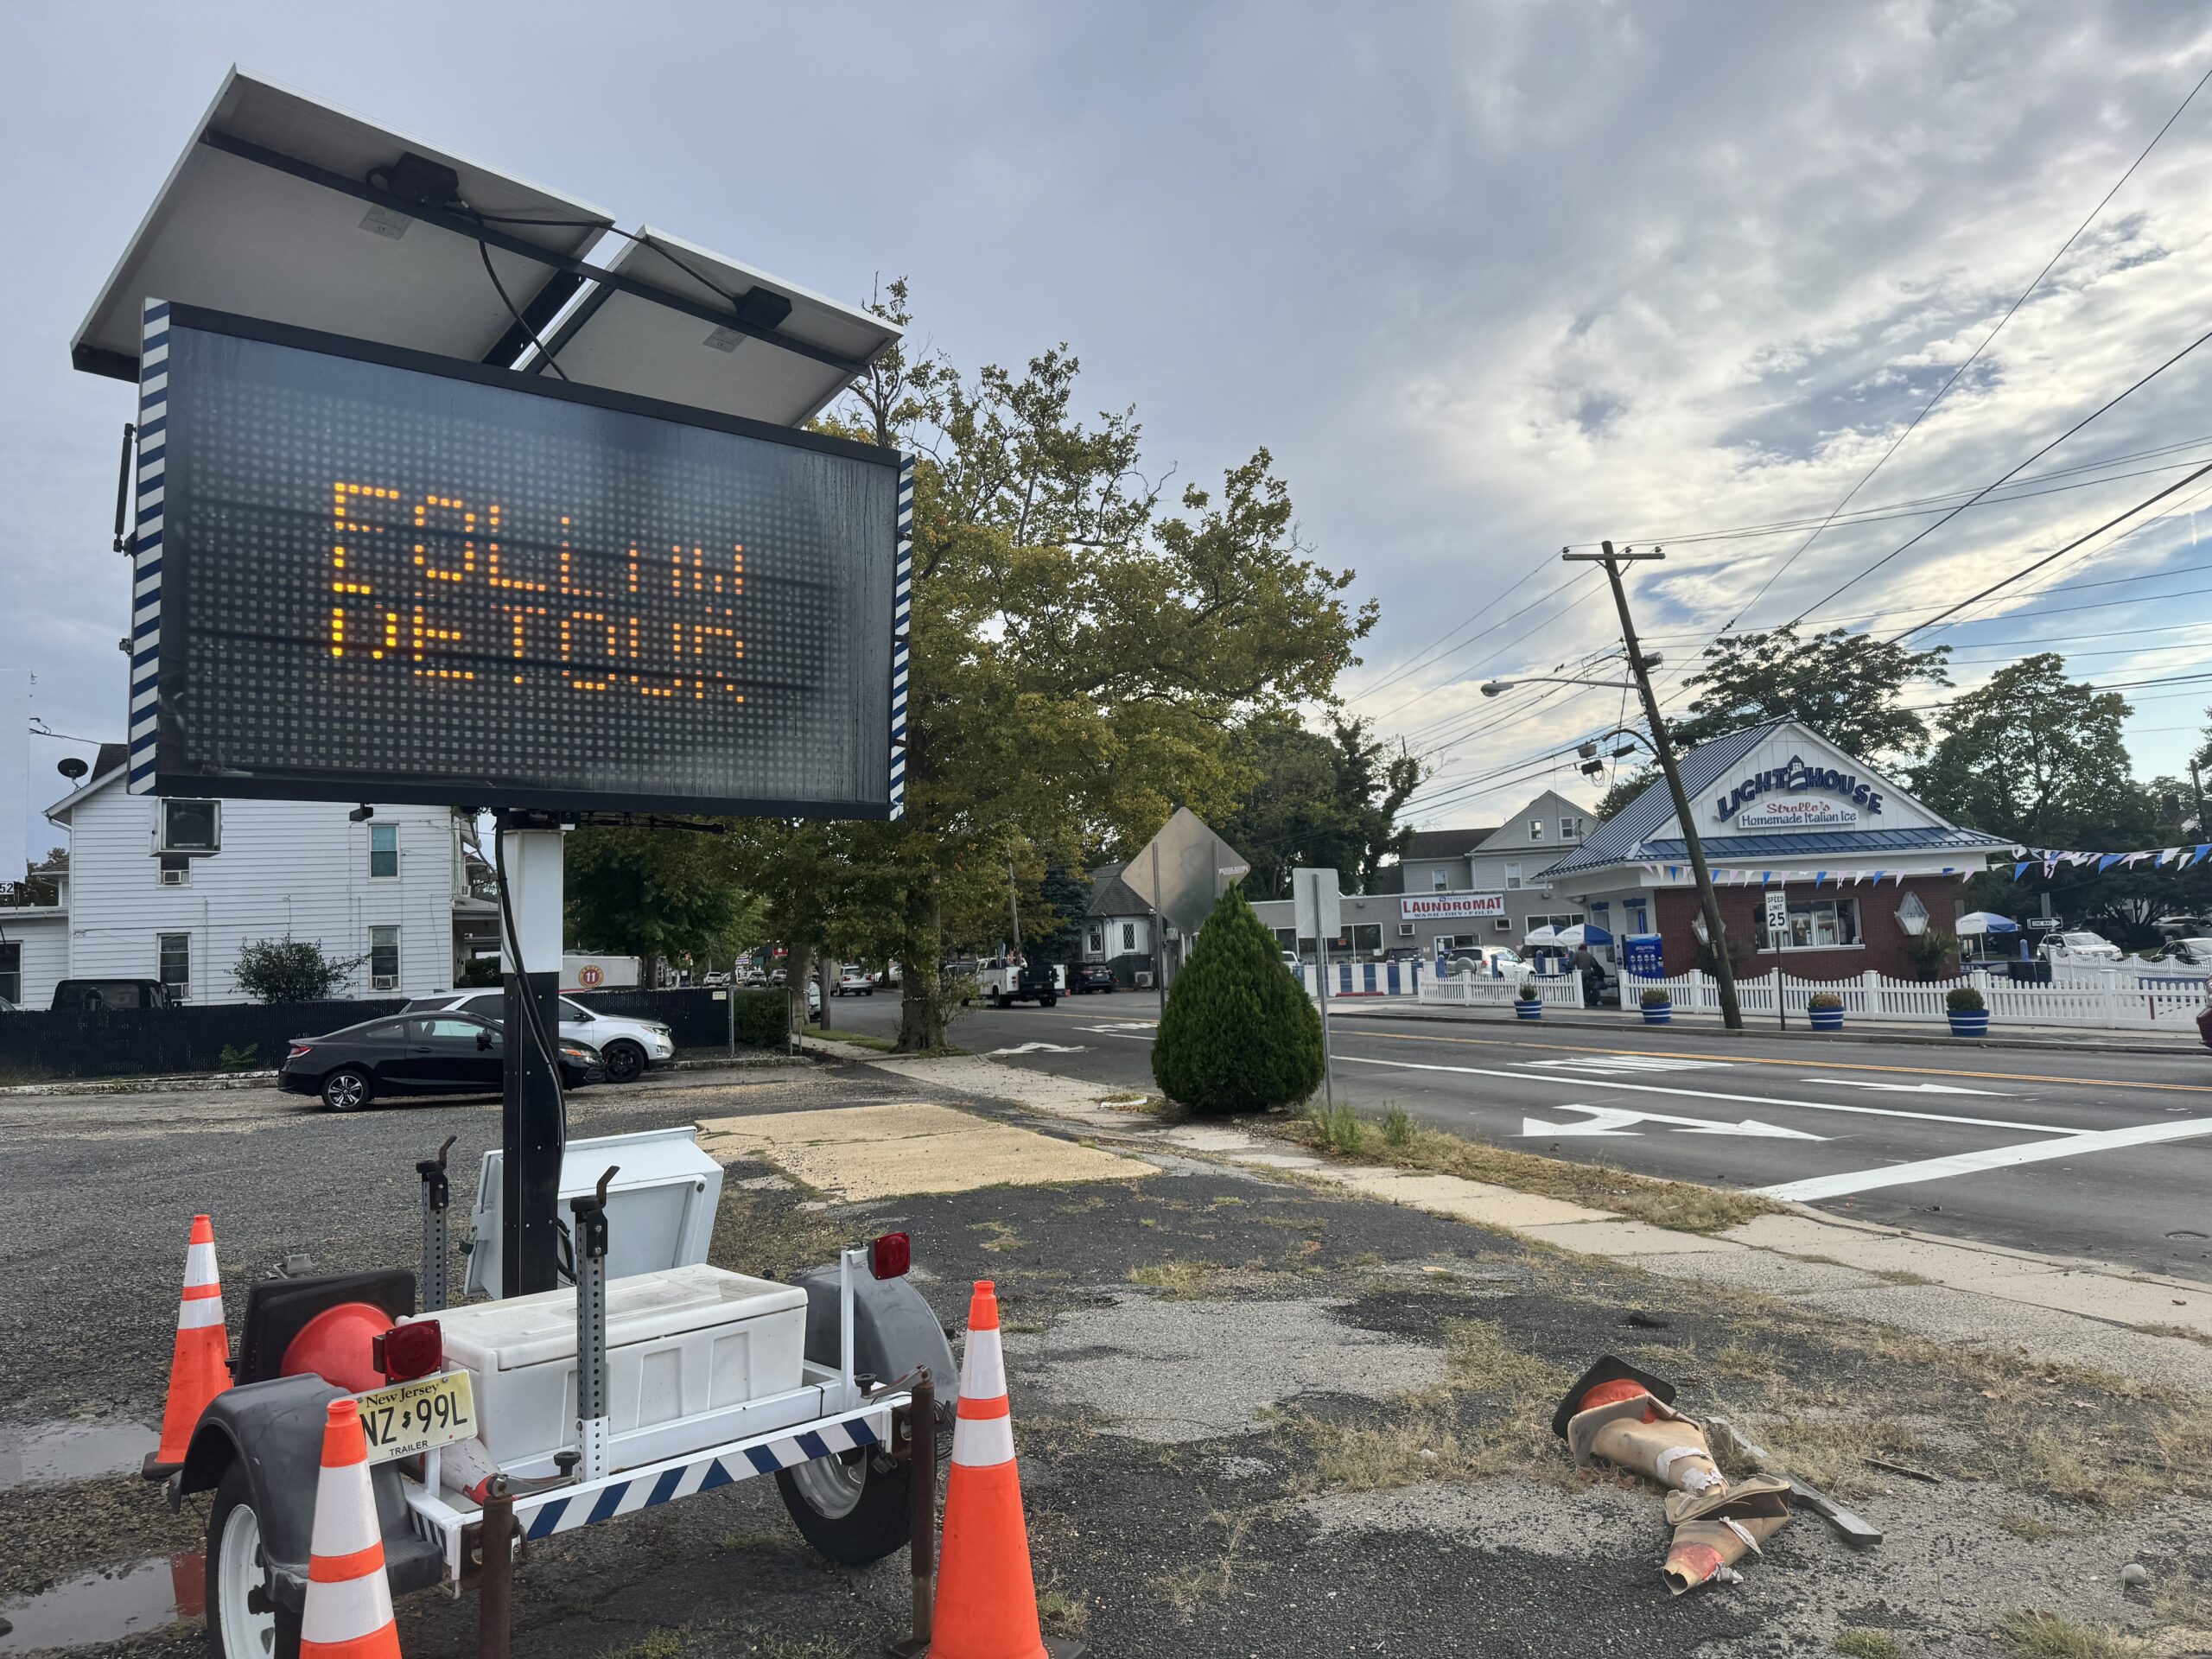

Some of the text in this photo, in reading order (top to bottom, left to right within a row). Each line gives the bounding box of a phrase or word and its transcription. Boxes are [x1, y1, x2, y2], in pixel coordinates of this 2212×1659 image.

[1766, 801, 1830, 814] Strollo's
[1742, 810, 1856, 826] Homemade Italian Ice
[1403, 896, 1502, 913] LAUNDROMAT
[1769, 912, 1785, 927] 25
[586, 971, 596, 982] 11
[366, 1383, 439, 1408] New Jersey
[389, 1440, 429, 1457] TRAILER
